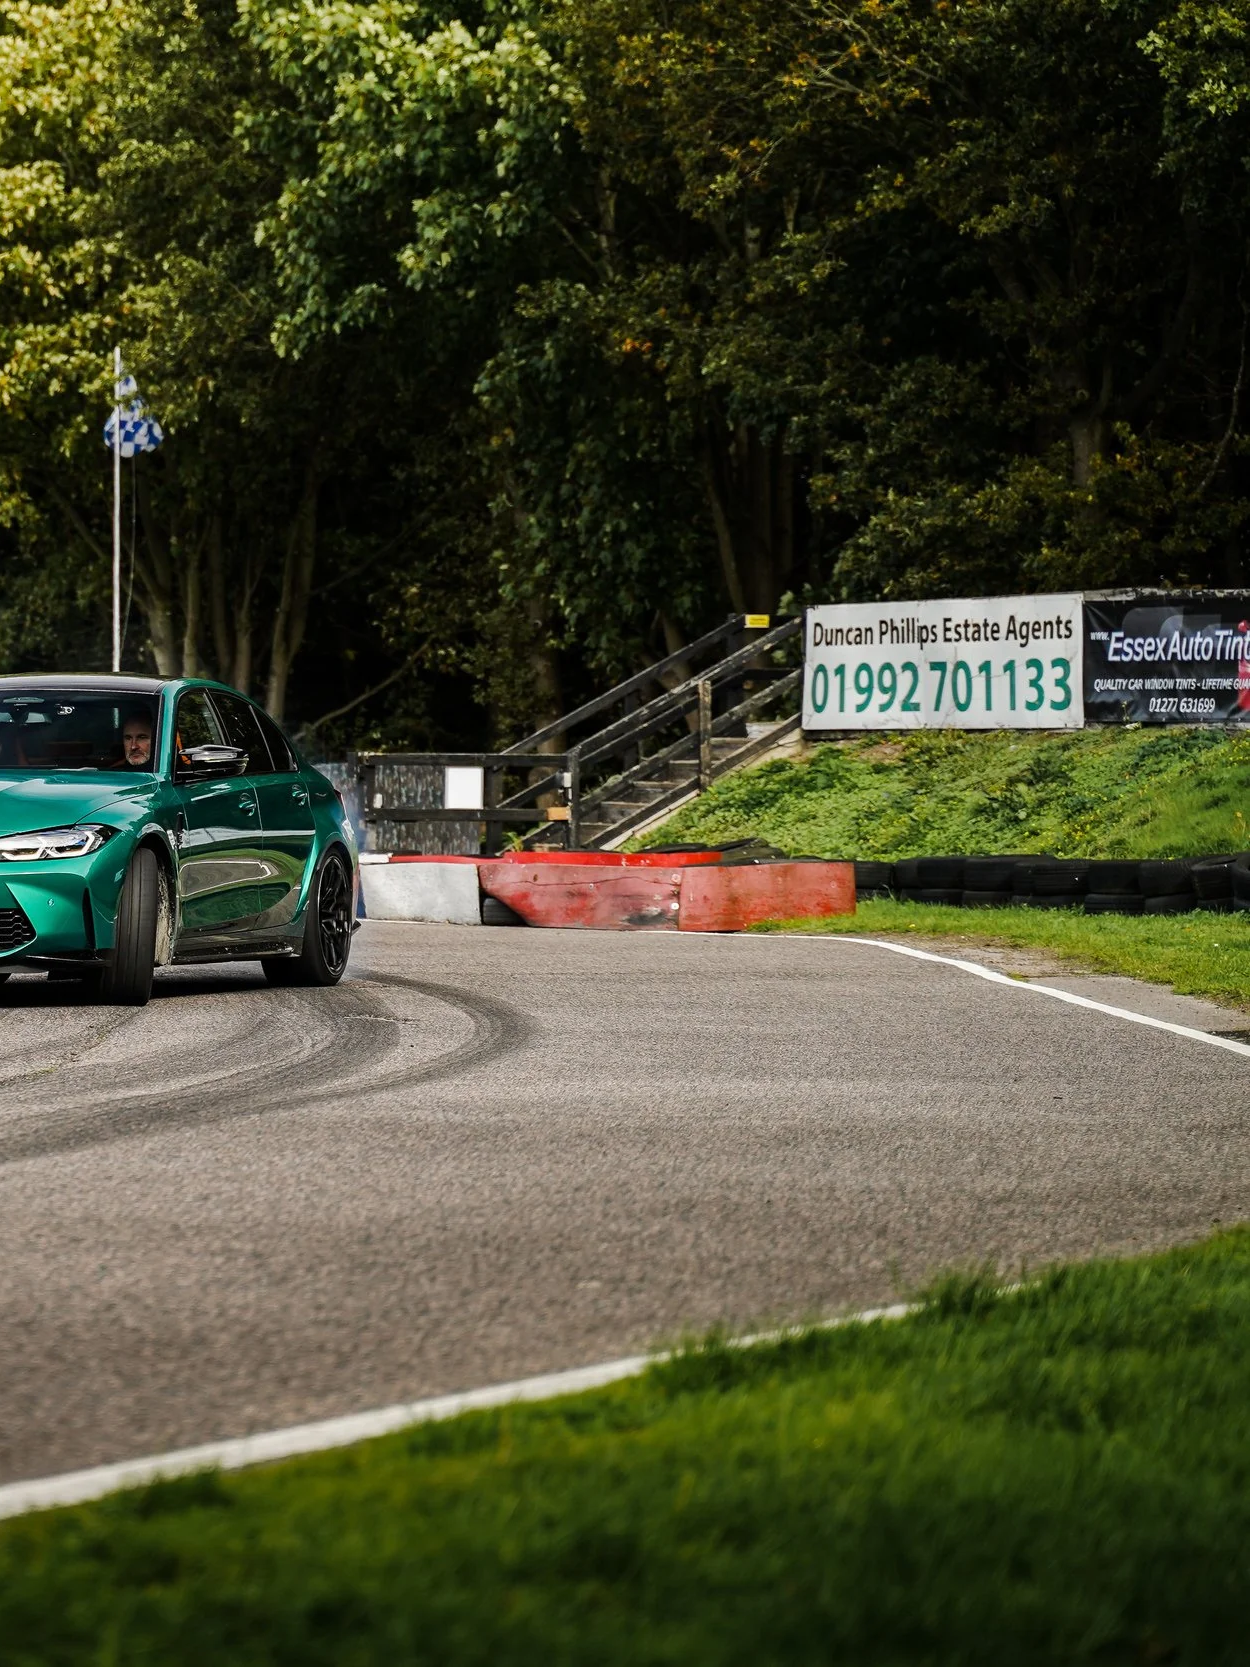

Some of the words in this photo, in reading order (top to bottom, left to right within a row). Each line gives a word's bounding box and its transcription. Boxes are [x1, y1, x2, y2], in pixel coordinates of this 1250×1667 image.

[812, 621, 874, 648] Duncan
[879, 618, 938, 650] Phillips
[942, 616, 1001, 643] Estate
[1004, 614, 1073, 649] Agents
[811, 662, 921, 713] 01992
[928, 657, 1073, 712] 701133
[1093, 678, 1128, 693] QUALITY
[1128, 678, 1143, 691] CAR
[1144, 678, 1175, 691] WINDOW
[1175, 678, 1196, 691] TINTS
[1201, 678, 1233, 691] LIFETIME
[1149, 697, 1178, 713] 01277
[1179, 697, 1216, 713] 631699
